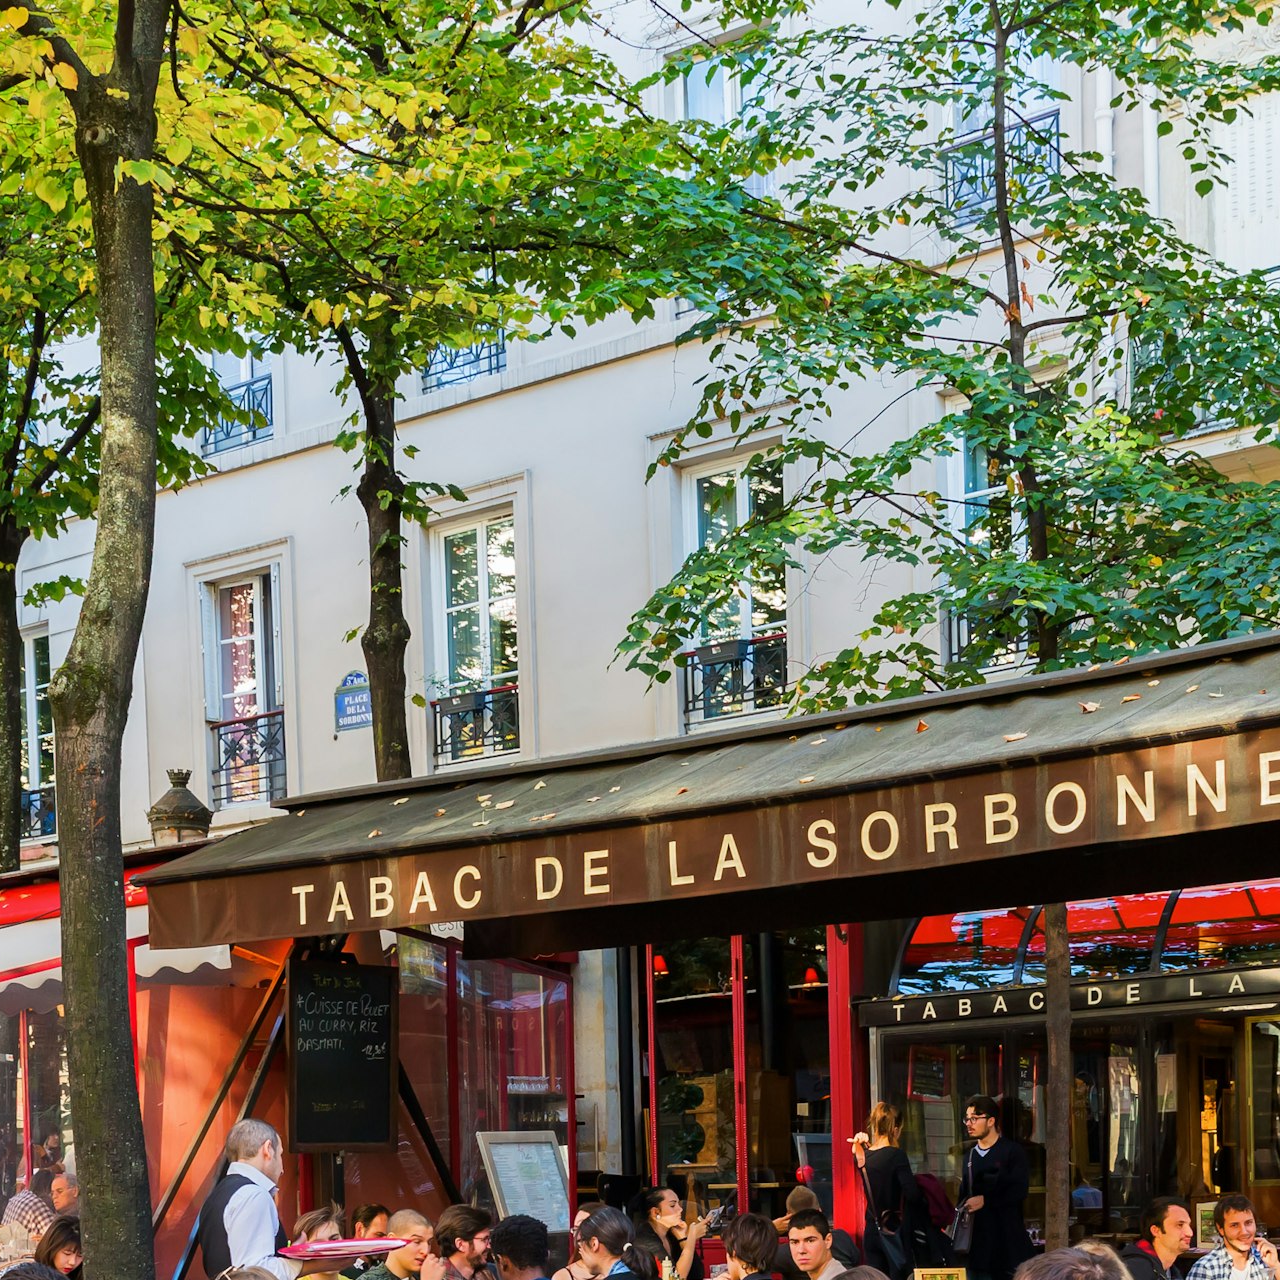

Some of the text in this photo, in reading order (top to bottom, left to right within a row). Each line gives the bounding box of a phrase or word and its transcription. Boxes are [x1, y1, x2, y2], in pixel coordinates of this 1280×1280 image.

[344, 694, 368, 705] PLACE
[346, 705, 366, 714] DE LA
[291, 864, 482, 926] TABAC
[534, 849, 611, 901] DE
[668, 833, 747, 887] LA
[346, 1000, 358, 1015] DE
[360, 993, 389, 1016] POULET
[892, 991, 1045, 1022] TABAC
[1087, 984, 1141, 1006] DE
[1189, 974, 1246, 997] LA
[299, 1019, 314, 1032] AU
